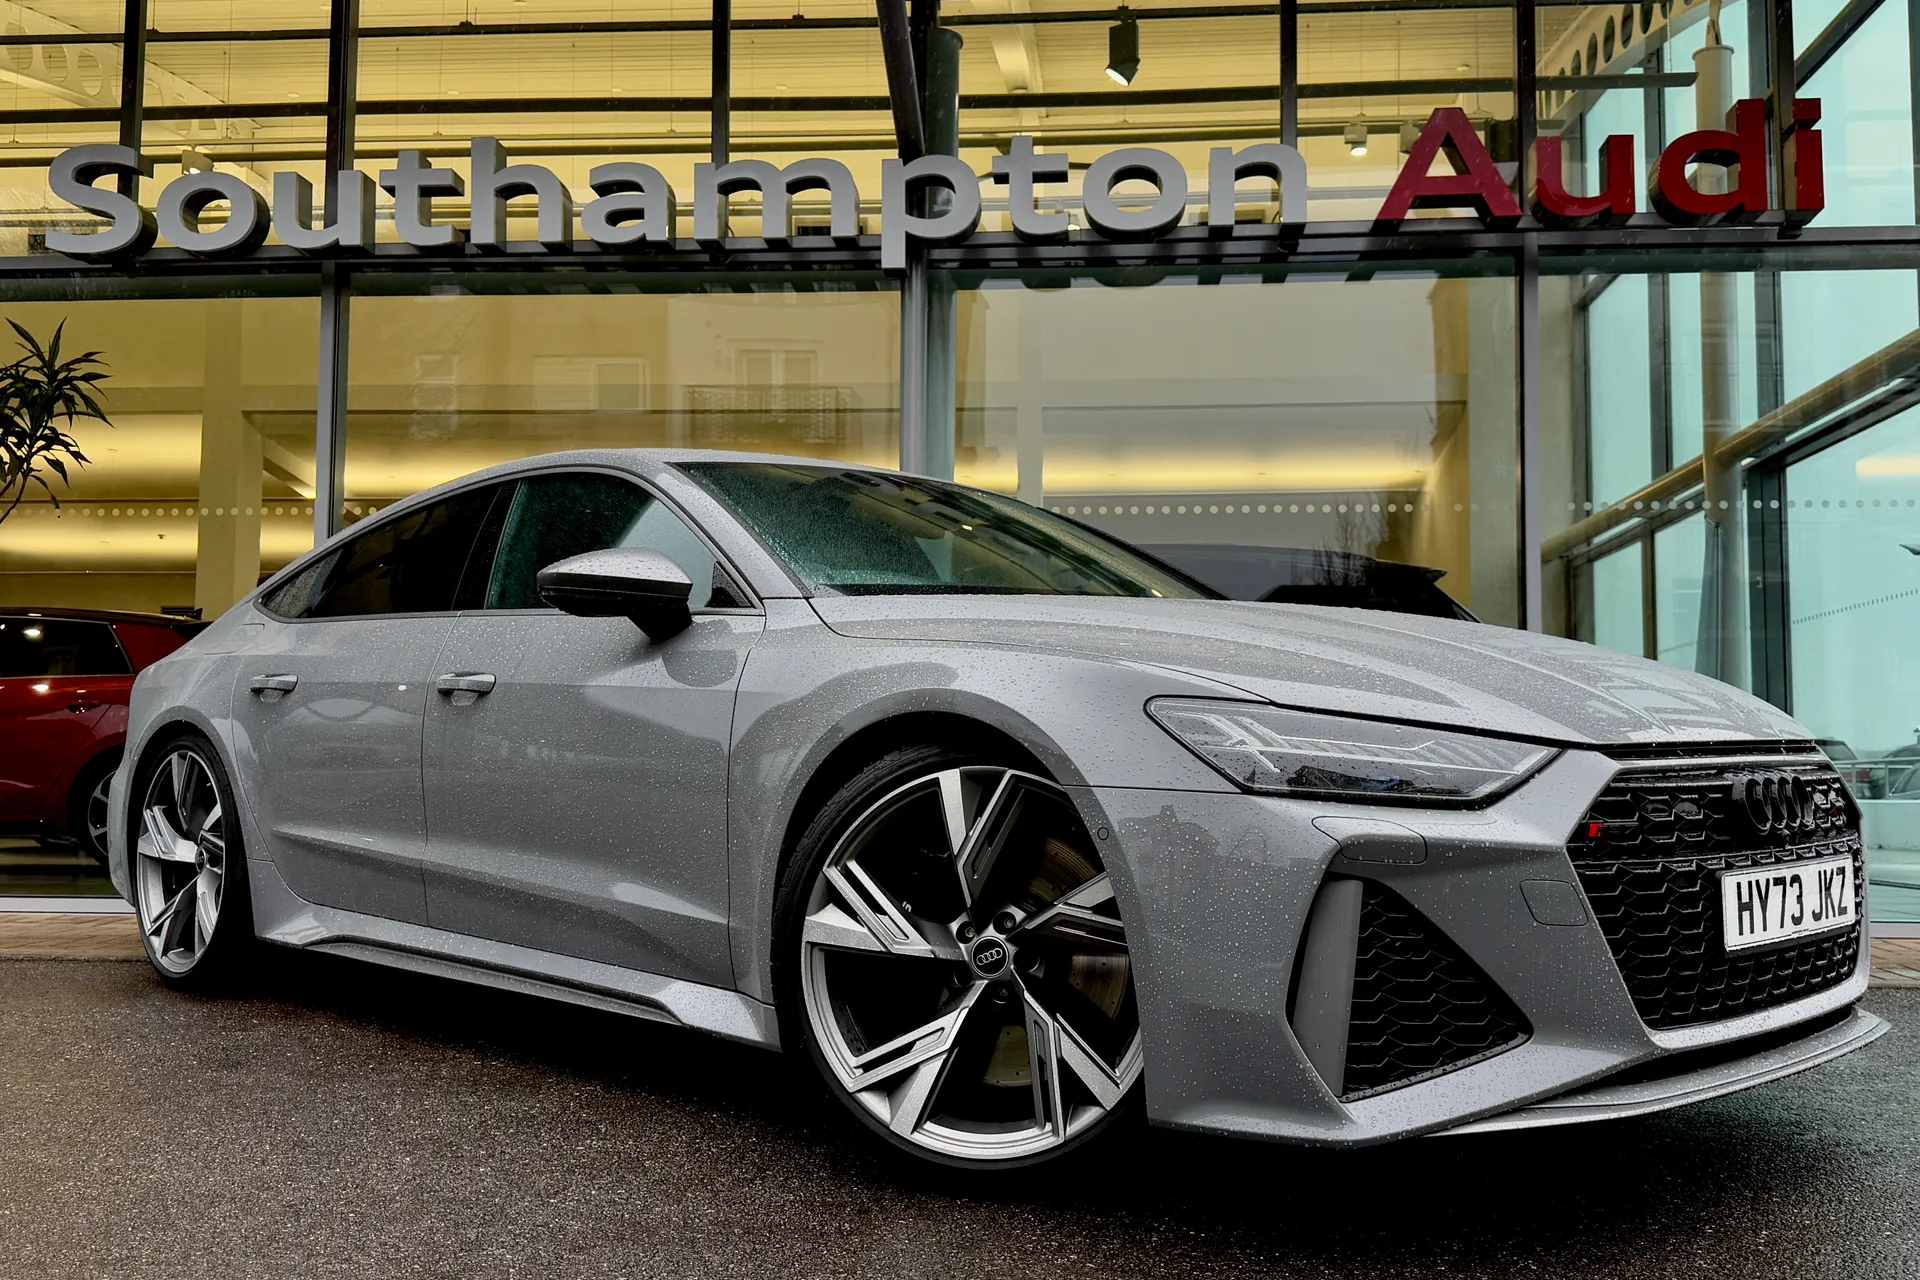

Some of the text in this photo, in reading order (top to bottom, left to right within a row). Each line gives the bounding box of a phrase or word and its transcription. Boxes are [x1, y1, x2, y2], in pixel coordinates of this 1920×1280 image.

[44, 97, 1825, 269] Southampton Audi
[1736, 866, 1848, 936] HY73 JKZ
